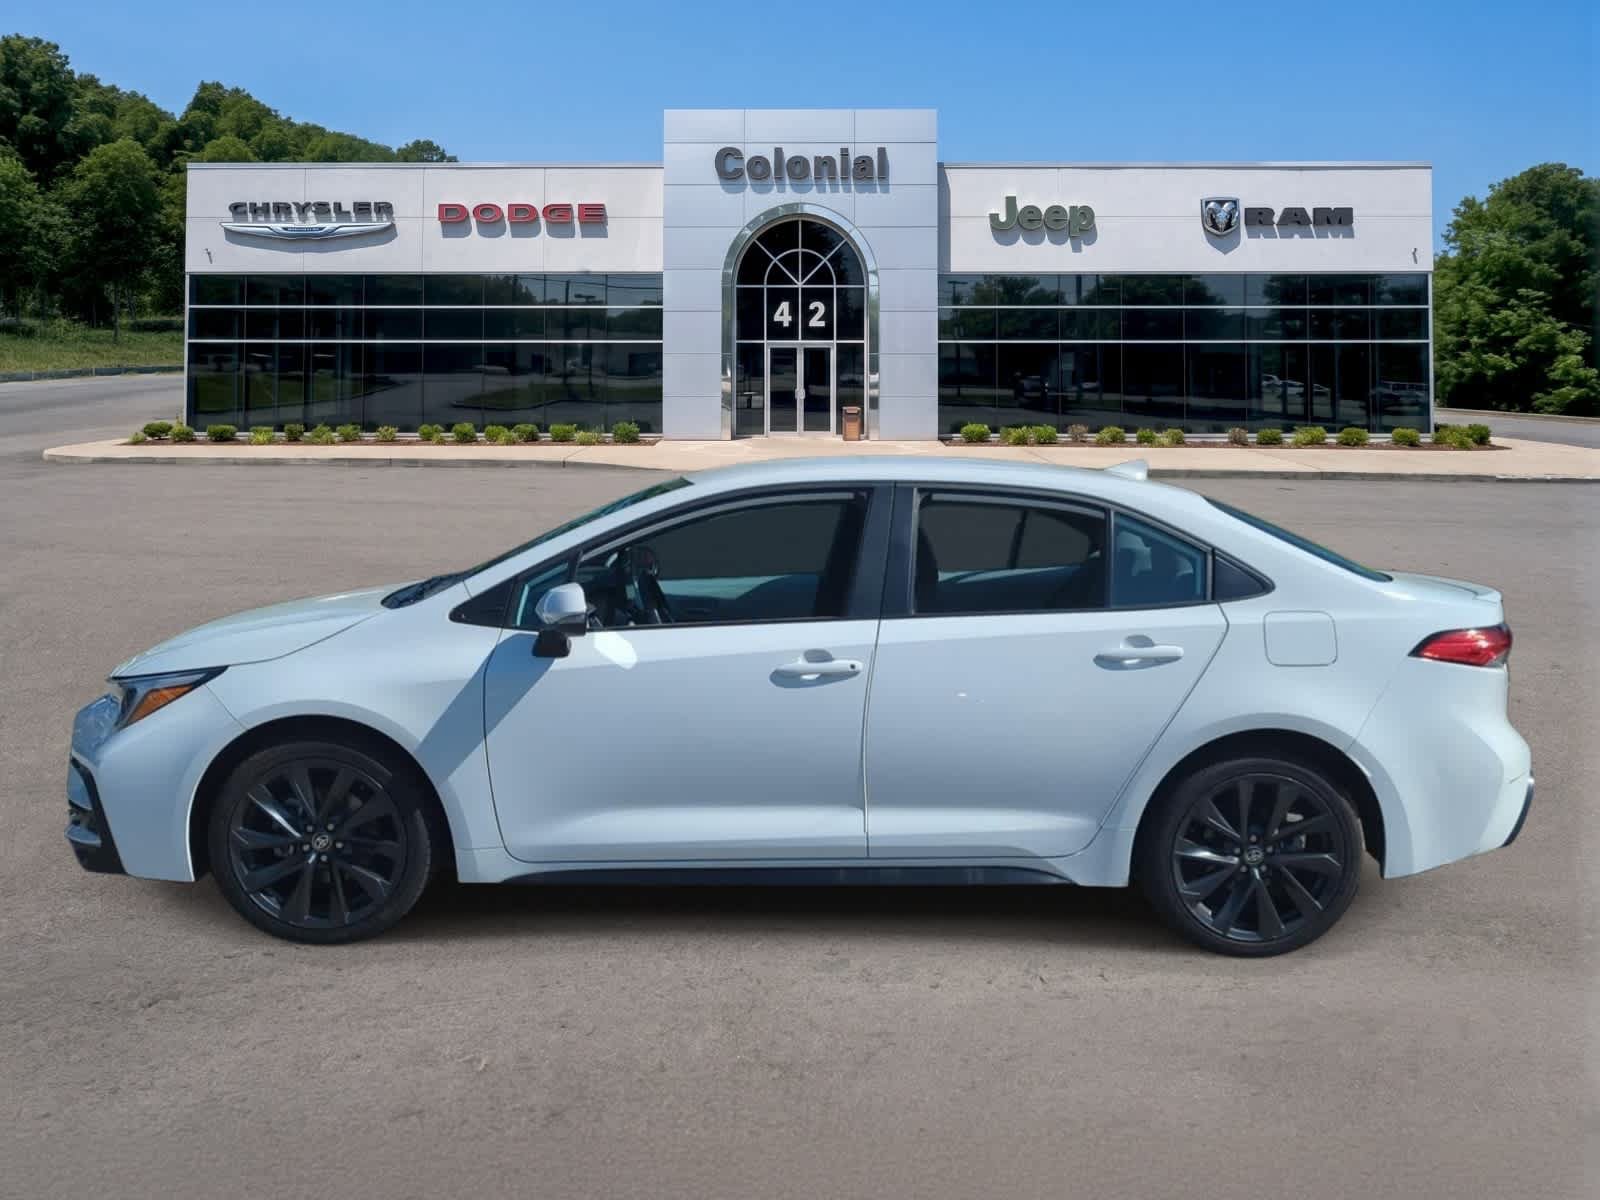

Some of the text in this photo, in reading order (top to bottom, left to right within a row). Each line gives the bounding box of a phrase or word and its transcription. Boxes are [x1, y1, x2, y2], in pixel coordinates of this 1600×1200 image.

[715, 147, 888, 180] Colonial
[228, 201, 393, 215] CHRYSLER
[437, 203, 606, 223] DODGE
[989, 196, 1096, 237] Jeep
[1244, 207, 1354, 226] RAM
